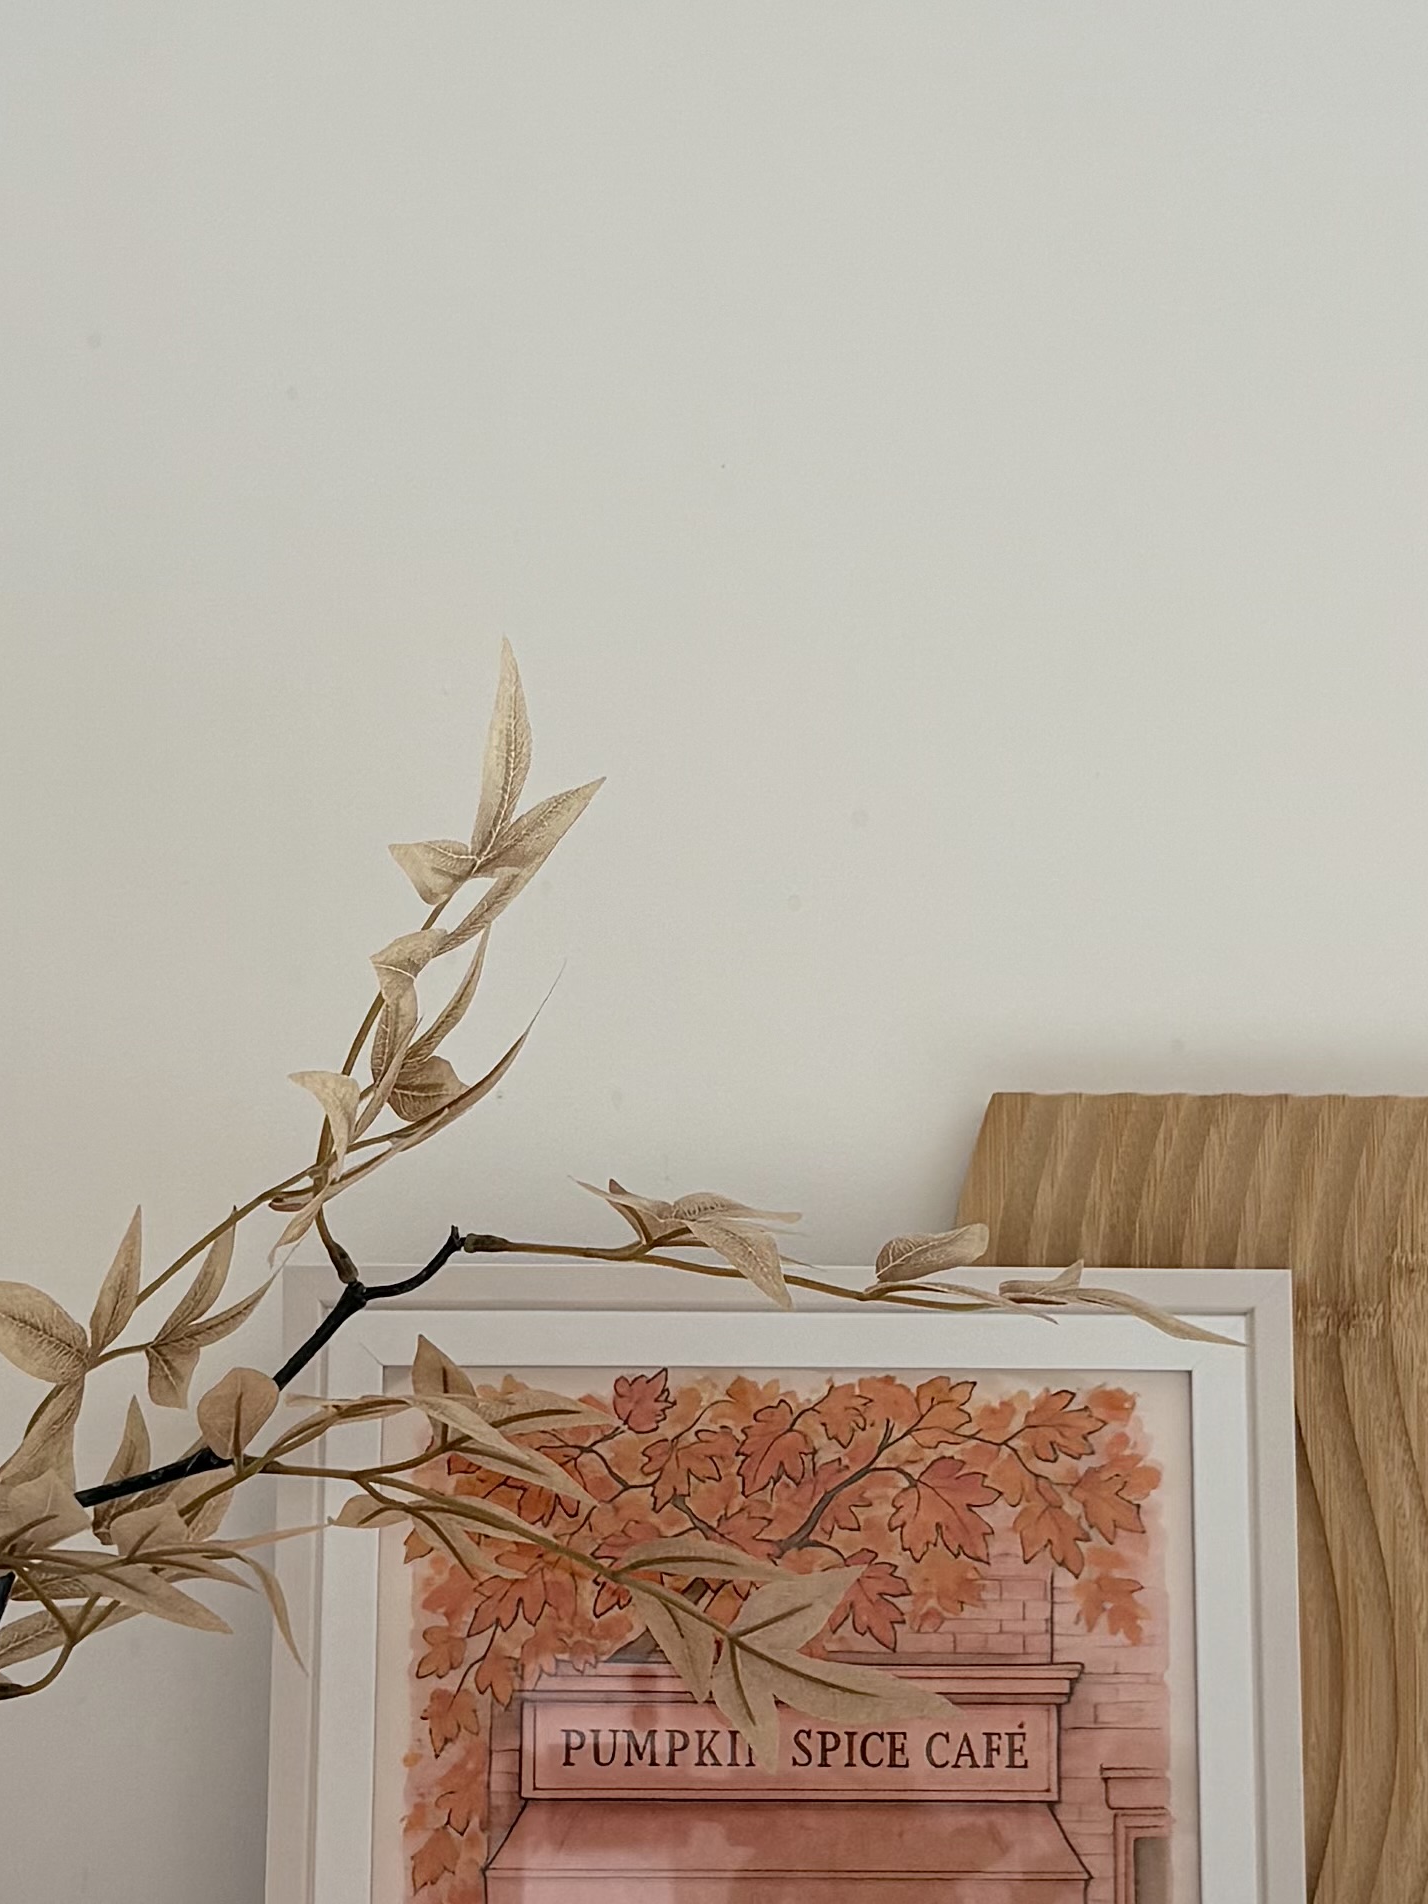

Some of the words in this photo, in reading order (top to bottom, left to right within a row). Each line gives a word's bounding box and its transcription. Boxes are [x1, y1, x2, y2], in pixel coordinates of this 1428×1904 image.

[561, 1727, 757, 1768] PUMPKI
[791, 1728, 911, 1769] SPICE
[924, 1721, 1030, 1770] CAFÉ
